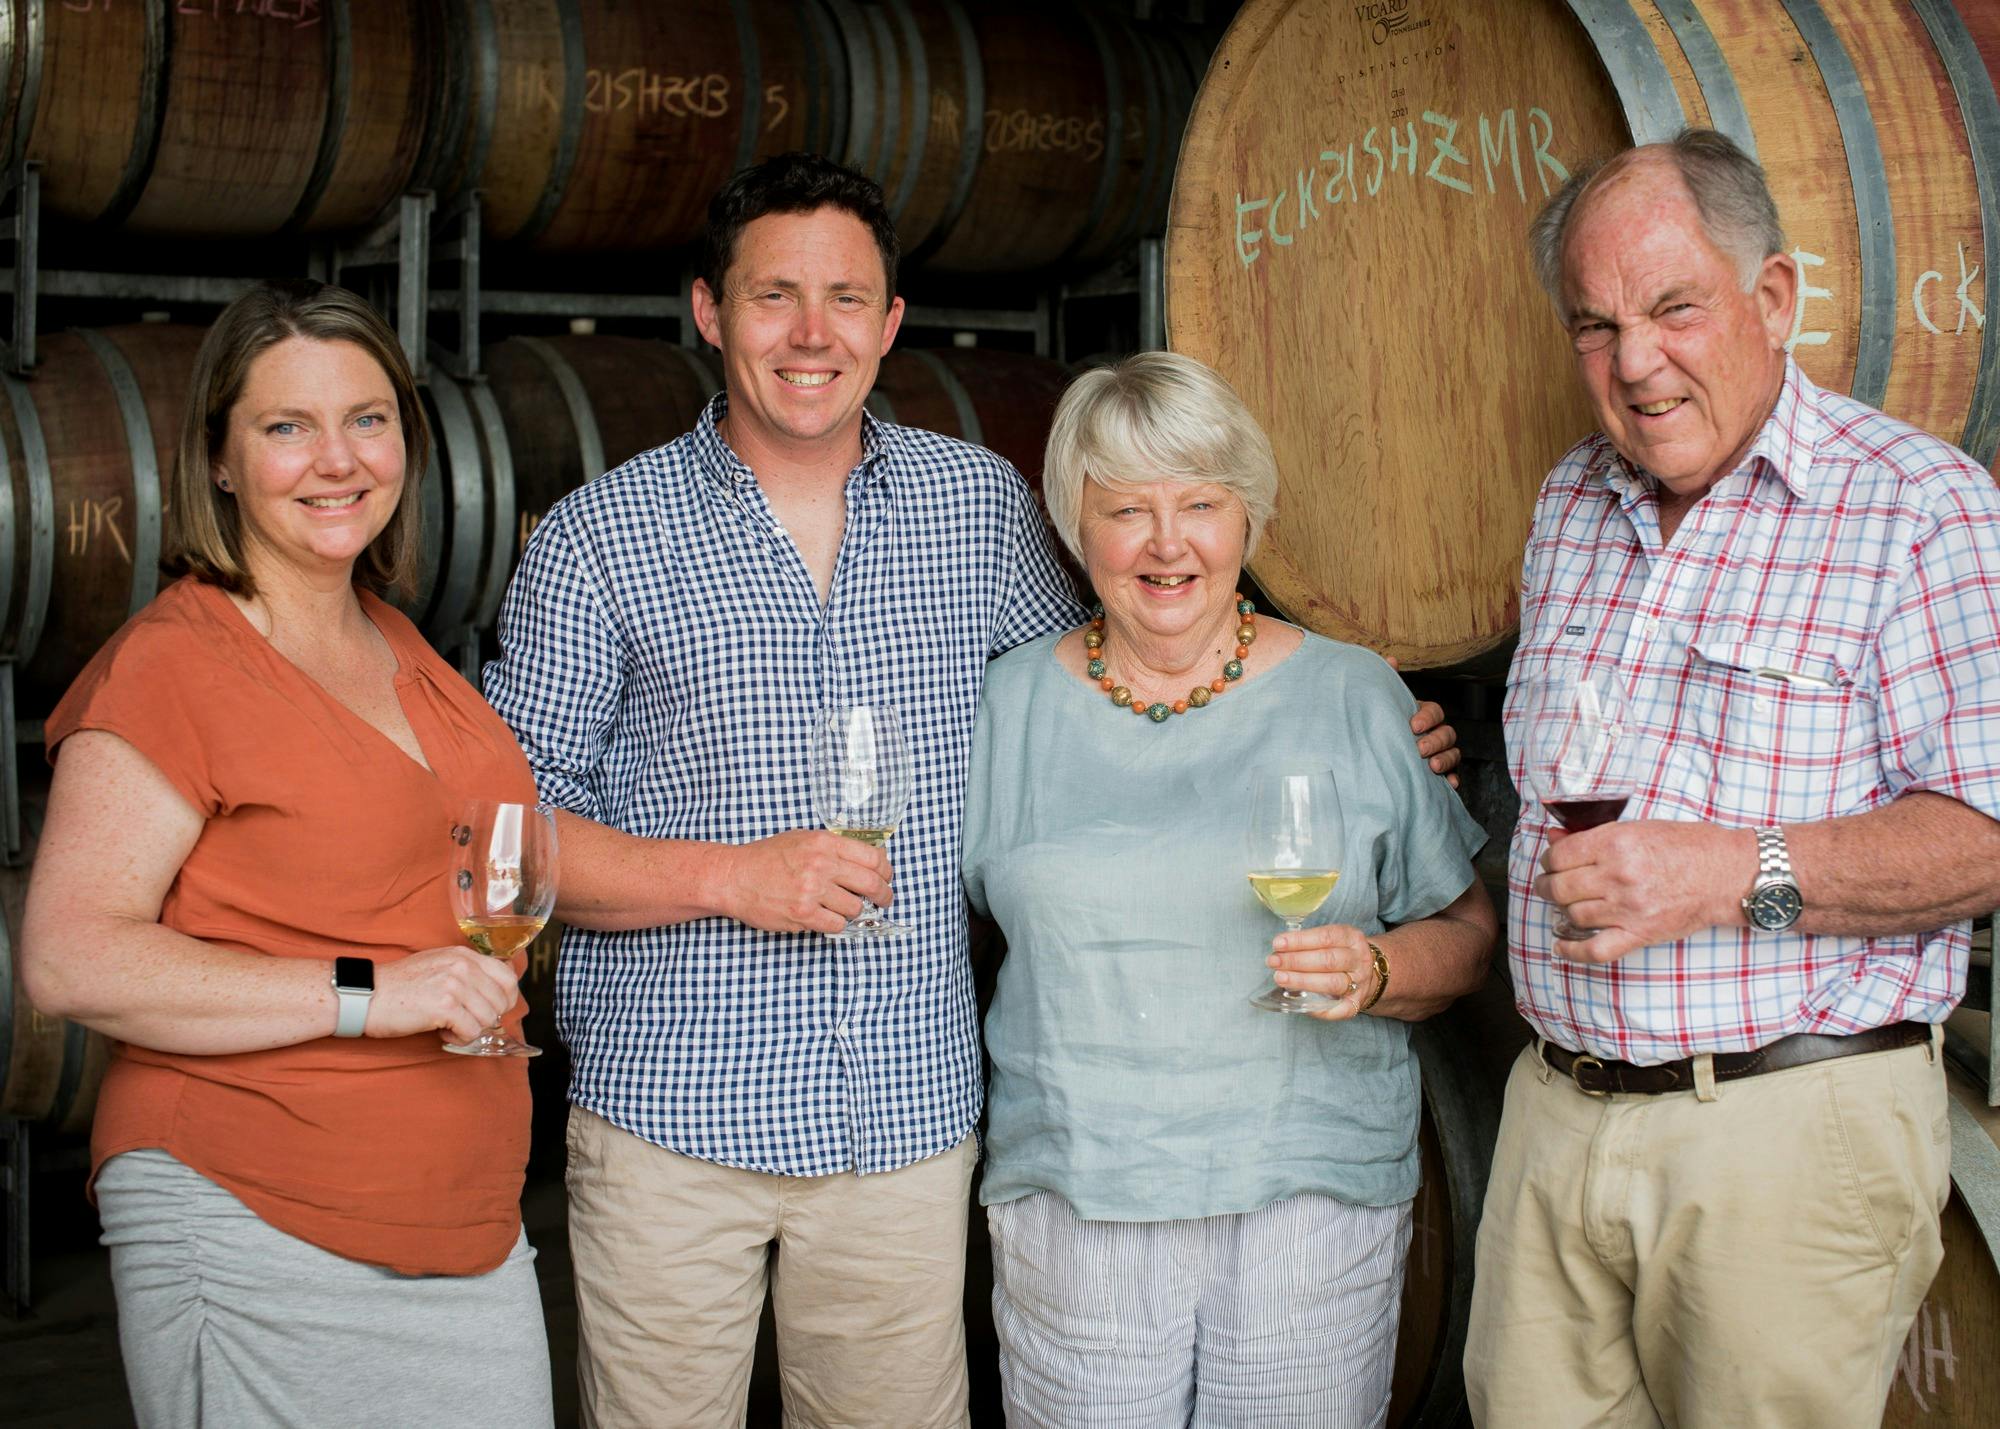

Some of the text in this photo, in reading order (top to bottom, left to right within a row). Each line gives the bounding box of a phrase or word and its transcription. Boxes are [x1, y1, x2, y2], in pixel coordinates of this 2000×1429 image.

[1338, 42, 1456, 84] DISTINCTION
[1391, 107, 1409, 119] 2021
[68, 496, 132, 565] HR
